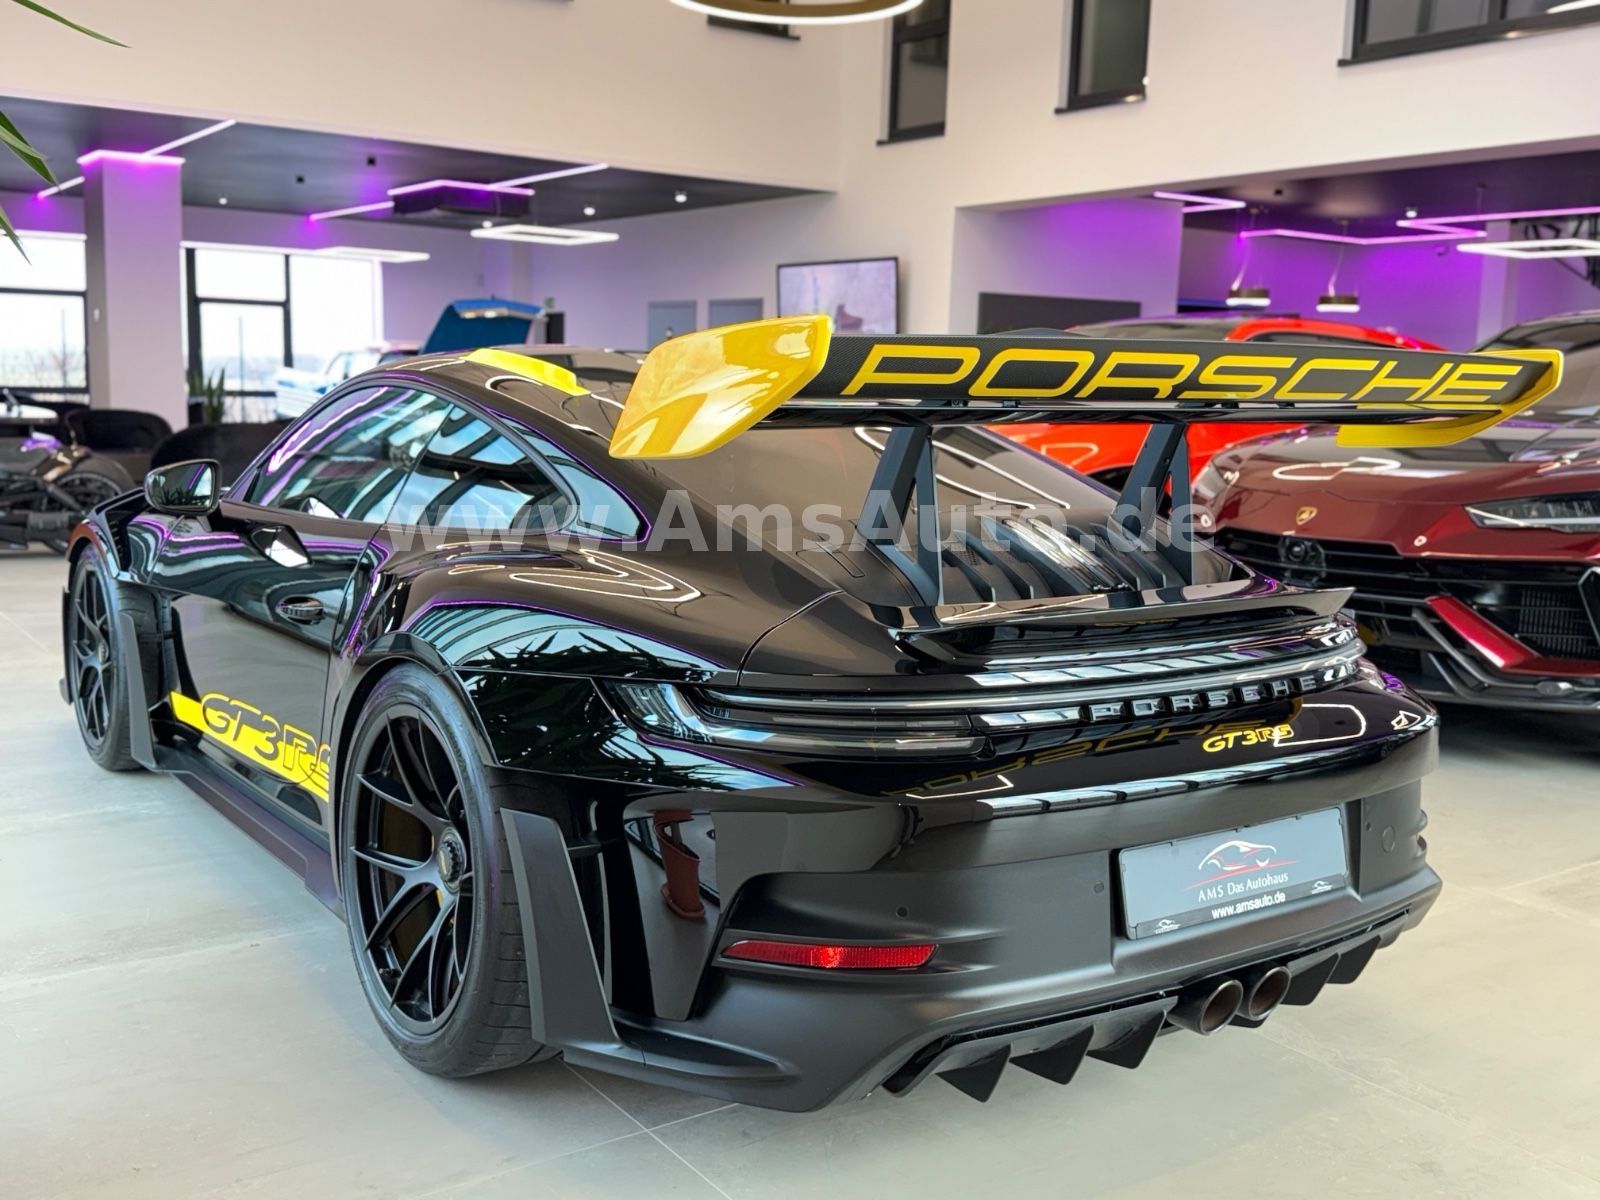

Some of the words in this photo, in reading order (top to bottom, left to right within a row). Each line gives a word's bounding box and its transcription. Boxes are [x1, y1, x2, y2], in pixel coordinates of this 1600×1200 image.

[841, 344, 1520, 402] PORSCHE
[1089, 674, 1317, 722] PORSCHE
[1202, 723, 1295, 753] GT3RS
[1198, 885, 1224, 902] AMS
[1227, 882, 1245, 896] Das
[1246, 872, 1289, 891] Autohaus
[1211, 890, 1286, 920] www.amsauto.de
